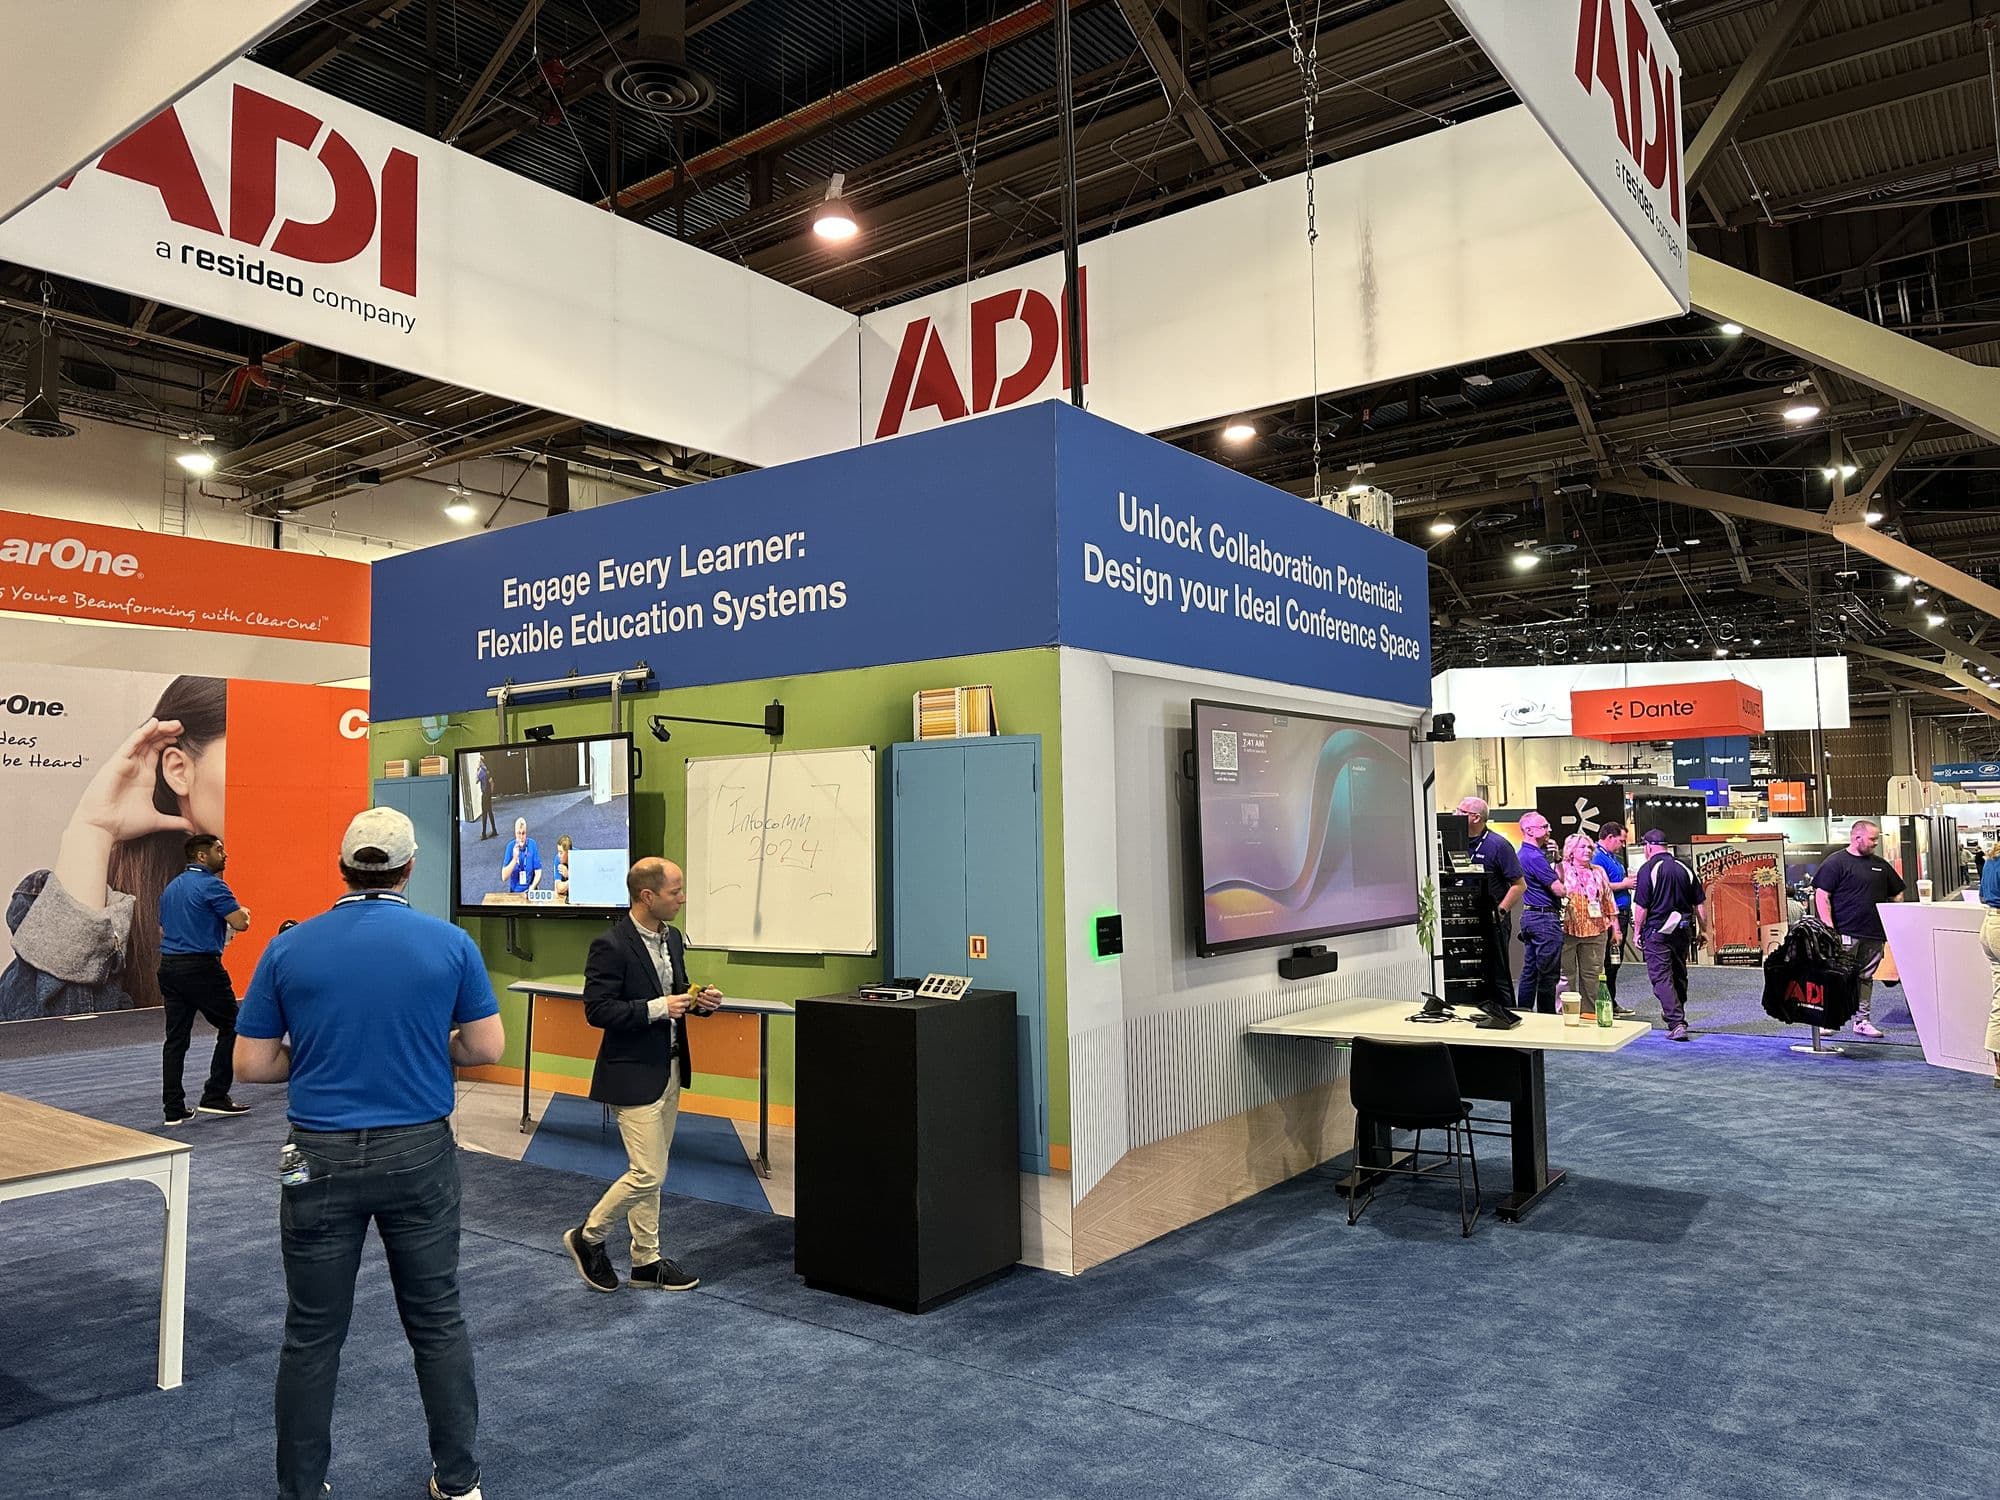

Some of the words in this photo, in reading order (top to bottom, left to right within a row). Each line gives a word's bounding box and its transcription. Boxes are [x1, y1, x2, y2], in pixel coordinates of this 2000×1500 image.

[1575, 0, 1681, 228] ADI
[1622, 164, 1655, 225] resideo
[1655, 215, 1682, 269] company
[155, 239, 171, 259] a
[181, 244, 304, 297] resideo
[312, 285, 417, 334] company
[875, 265, 1089, 440] ADI
[503, 571, 590, 611] Engage
[599, 556, 672, 592] Every
[680, 530, 806, 578] Learner:
[1119, 491, 1203, 553] Unlock
[1209, 523, 1332, 592] Collaboration
[1337, 565, 1403, 613] Potential:
[12, 586, 68, 604] You're
[73, 591, 196, 623] Beamforming
[202, 608, 242, 622] with
[477, 619, 563, 660] Flexible
[571, 601, 703, 647] Education
[712, 580, 847, 631] Systems
[1084, 542, 1173, 605] Design
[1179, 574, 1229, 613] your
[1234, 583, 1281, 627] Ideal
[1285, 597, 1377, 650] Conference
[1379, 624, 1420, 660] Space
[1630, 700, 1694, 718] Dante
[3, 753, 22, 767] be
[29, 753, 82, 768] Heard
[748, 836, 823, 868] 2024
[1699, 846, 1735, 866] DANTE
[1737, 853, 1777, 866] UNIVERSE
